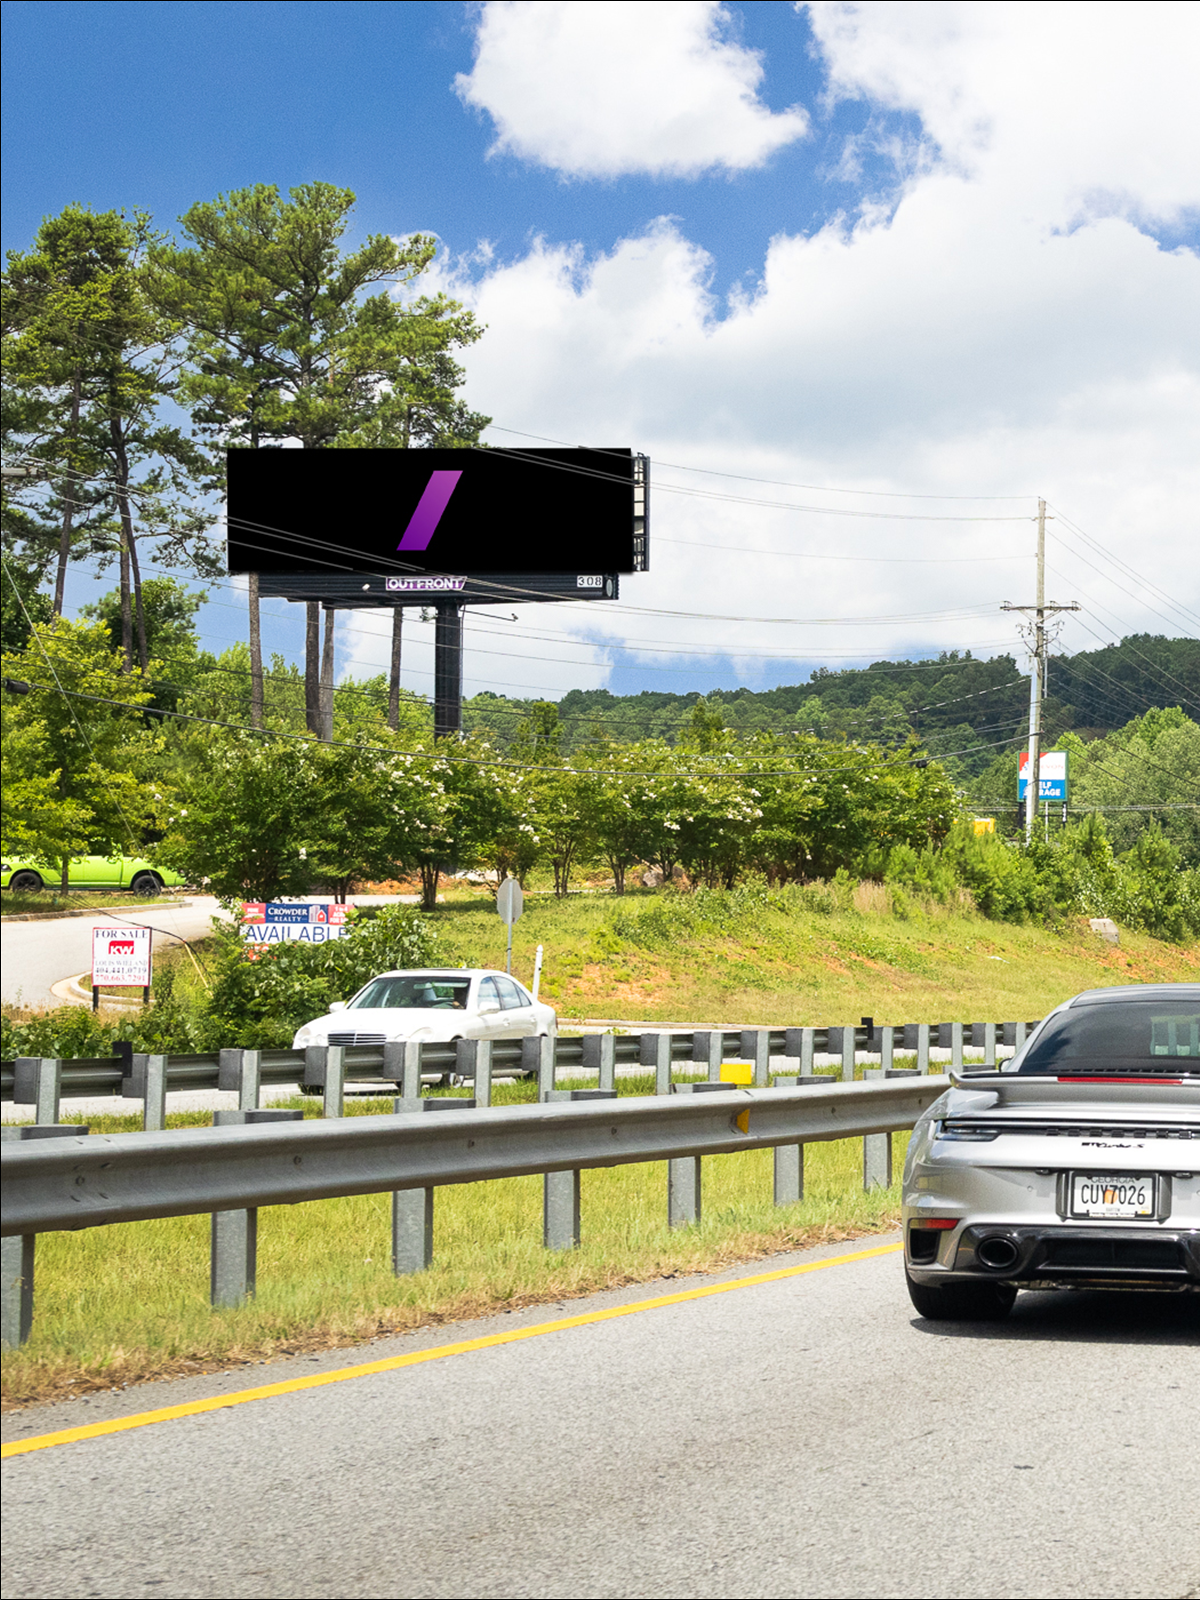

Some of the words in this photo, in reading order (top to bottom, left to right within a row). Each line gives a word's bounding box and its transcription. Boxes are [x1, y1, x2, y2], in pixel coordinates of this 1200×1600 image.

[389, 578, 464, 590] OUTFRONT
[579, 576, 602, 586] 308
[268, 907, 308, 916] CROWDER
[96, 930, 118, 939] FOR
[120, 930, 148, 939] SALE
[244, 925, 351, 942] AVAILABLE
[1091, 1176, 1135, 1184] GEORGIA
[1081, 1184, 1145, 1205] CUY7026
